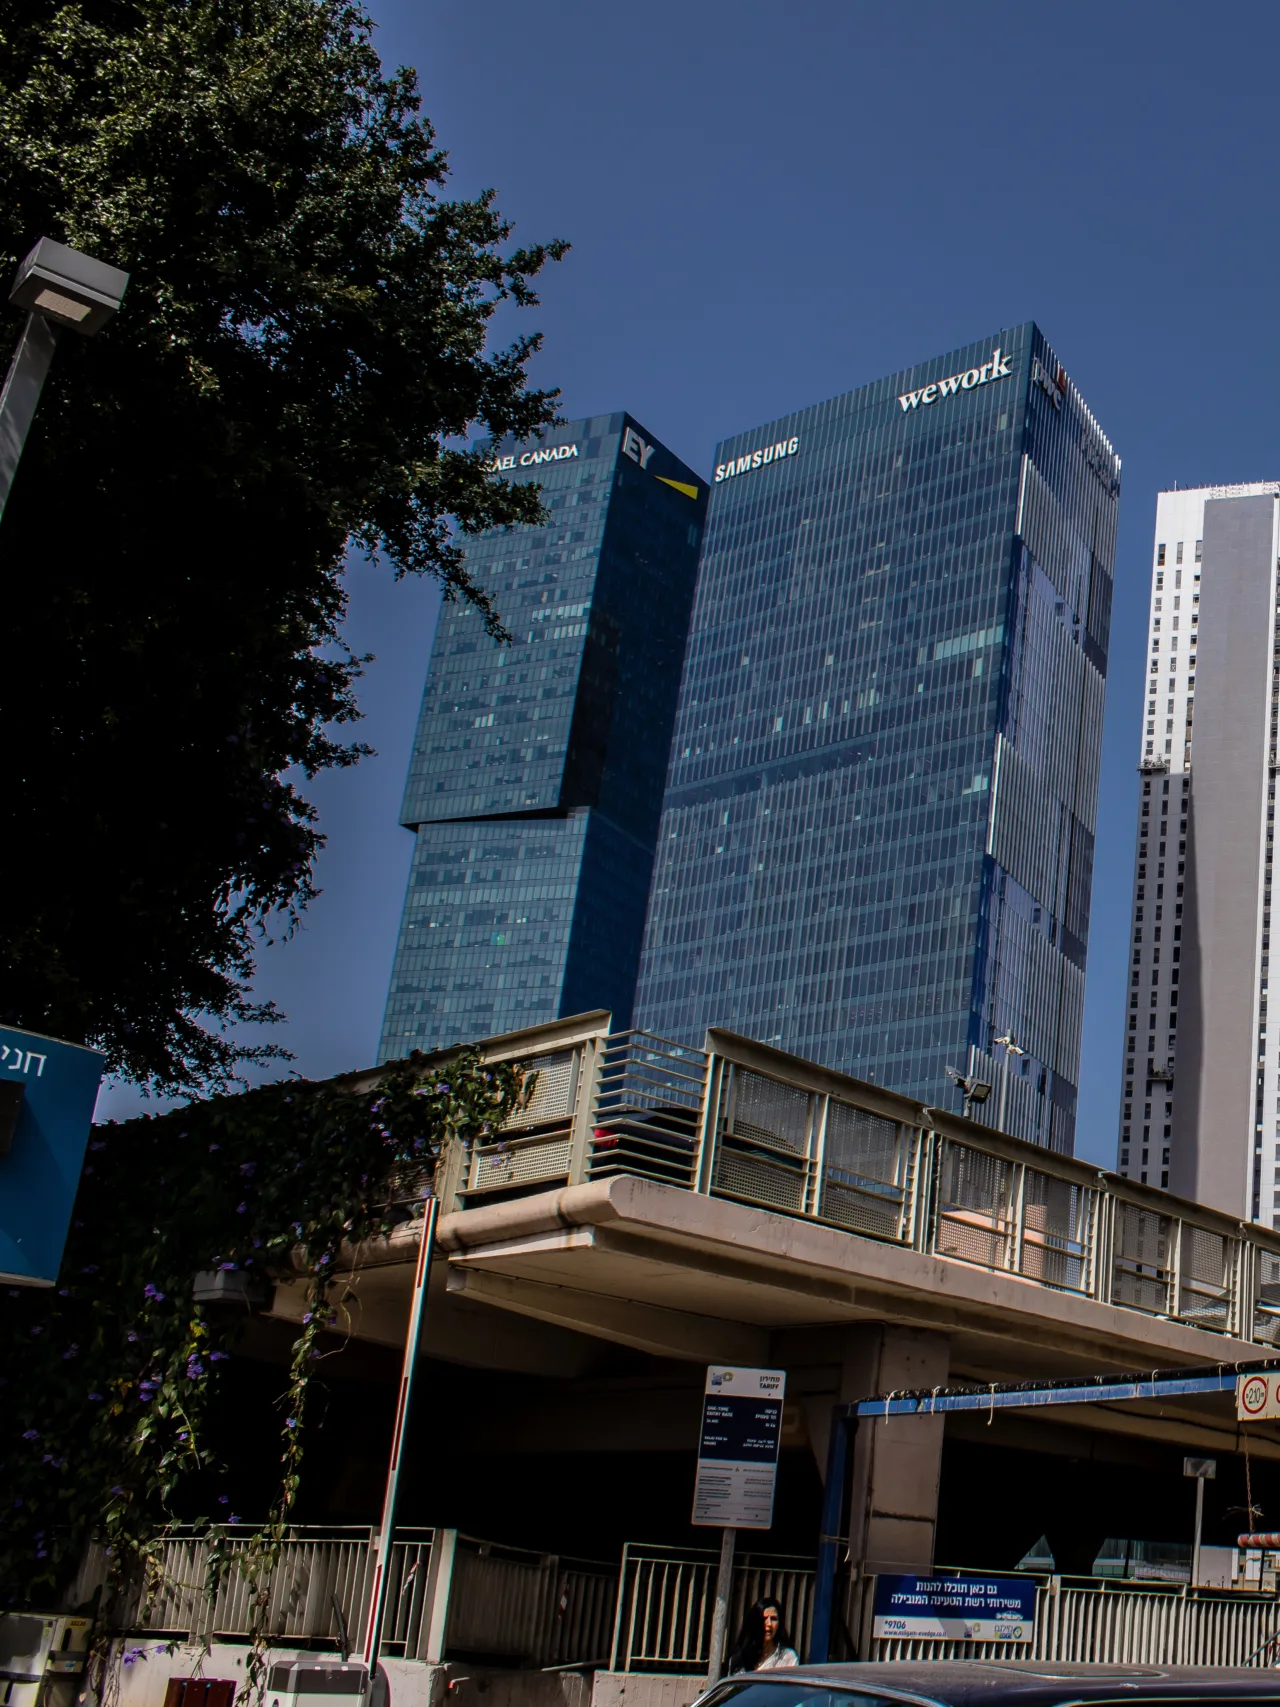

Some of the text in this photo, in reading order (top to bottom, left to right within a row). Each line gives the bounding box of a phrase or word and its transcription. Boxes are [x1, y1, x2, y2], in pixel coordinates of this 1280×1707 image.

[899, 348, 1012, 412] wework
[519, 444, 579, 466] CANADA
[622, 426, 655, 470] EY
[715, 436, 799, 483] SAMSUNG
[891, 1592, 1021, 1609] משירותי רשת הטעינה המובילה
[916, 1581, 997, 1596] גם כאן תוכלו להנות
